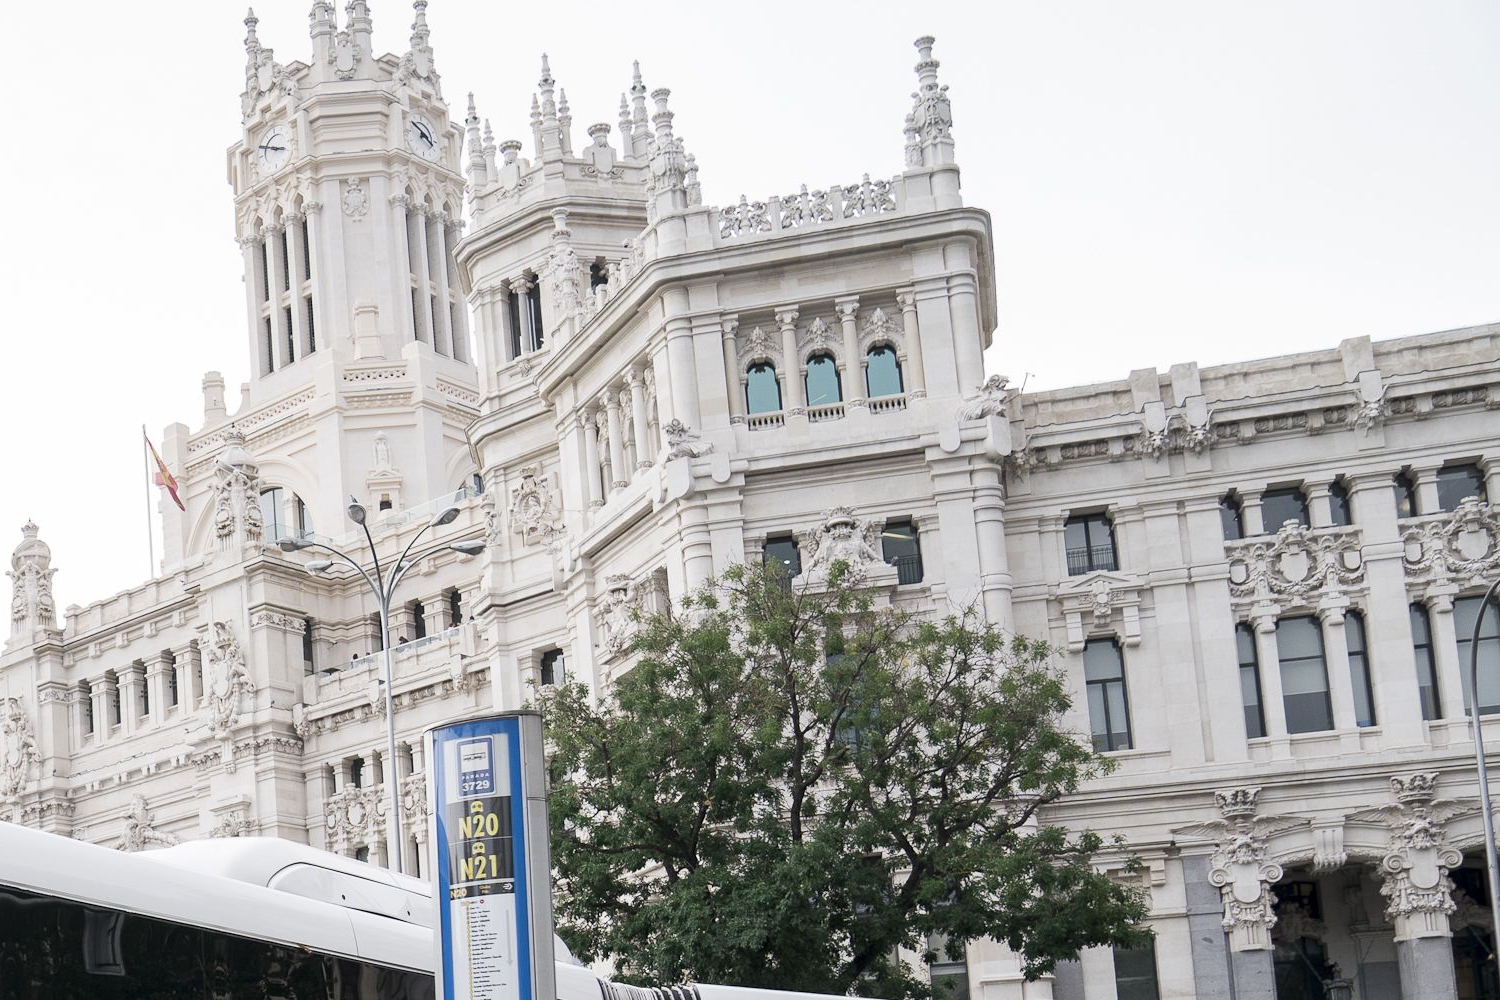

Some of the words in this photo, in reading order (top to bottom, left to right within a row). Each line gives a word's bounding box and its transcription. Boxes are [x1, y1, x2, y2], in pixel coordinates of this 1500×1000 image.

[462, 780, 490, 792] 3729
[458, 813, 499, 840] N20
[460, 854, 498, 881] N21
[450, 887, 467, 900] N20
